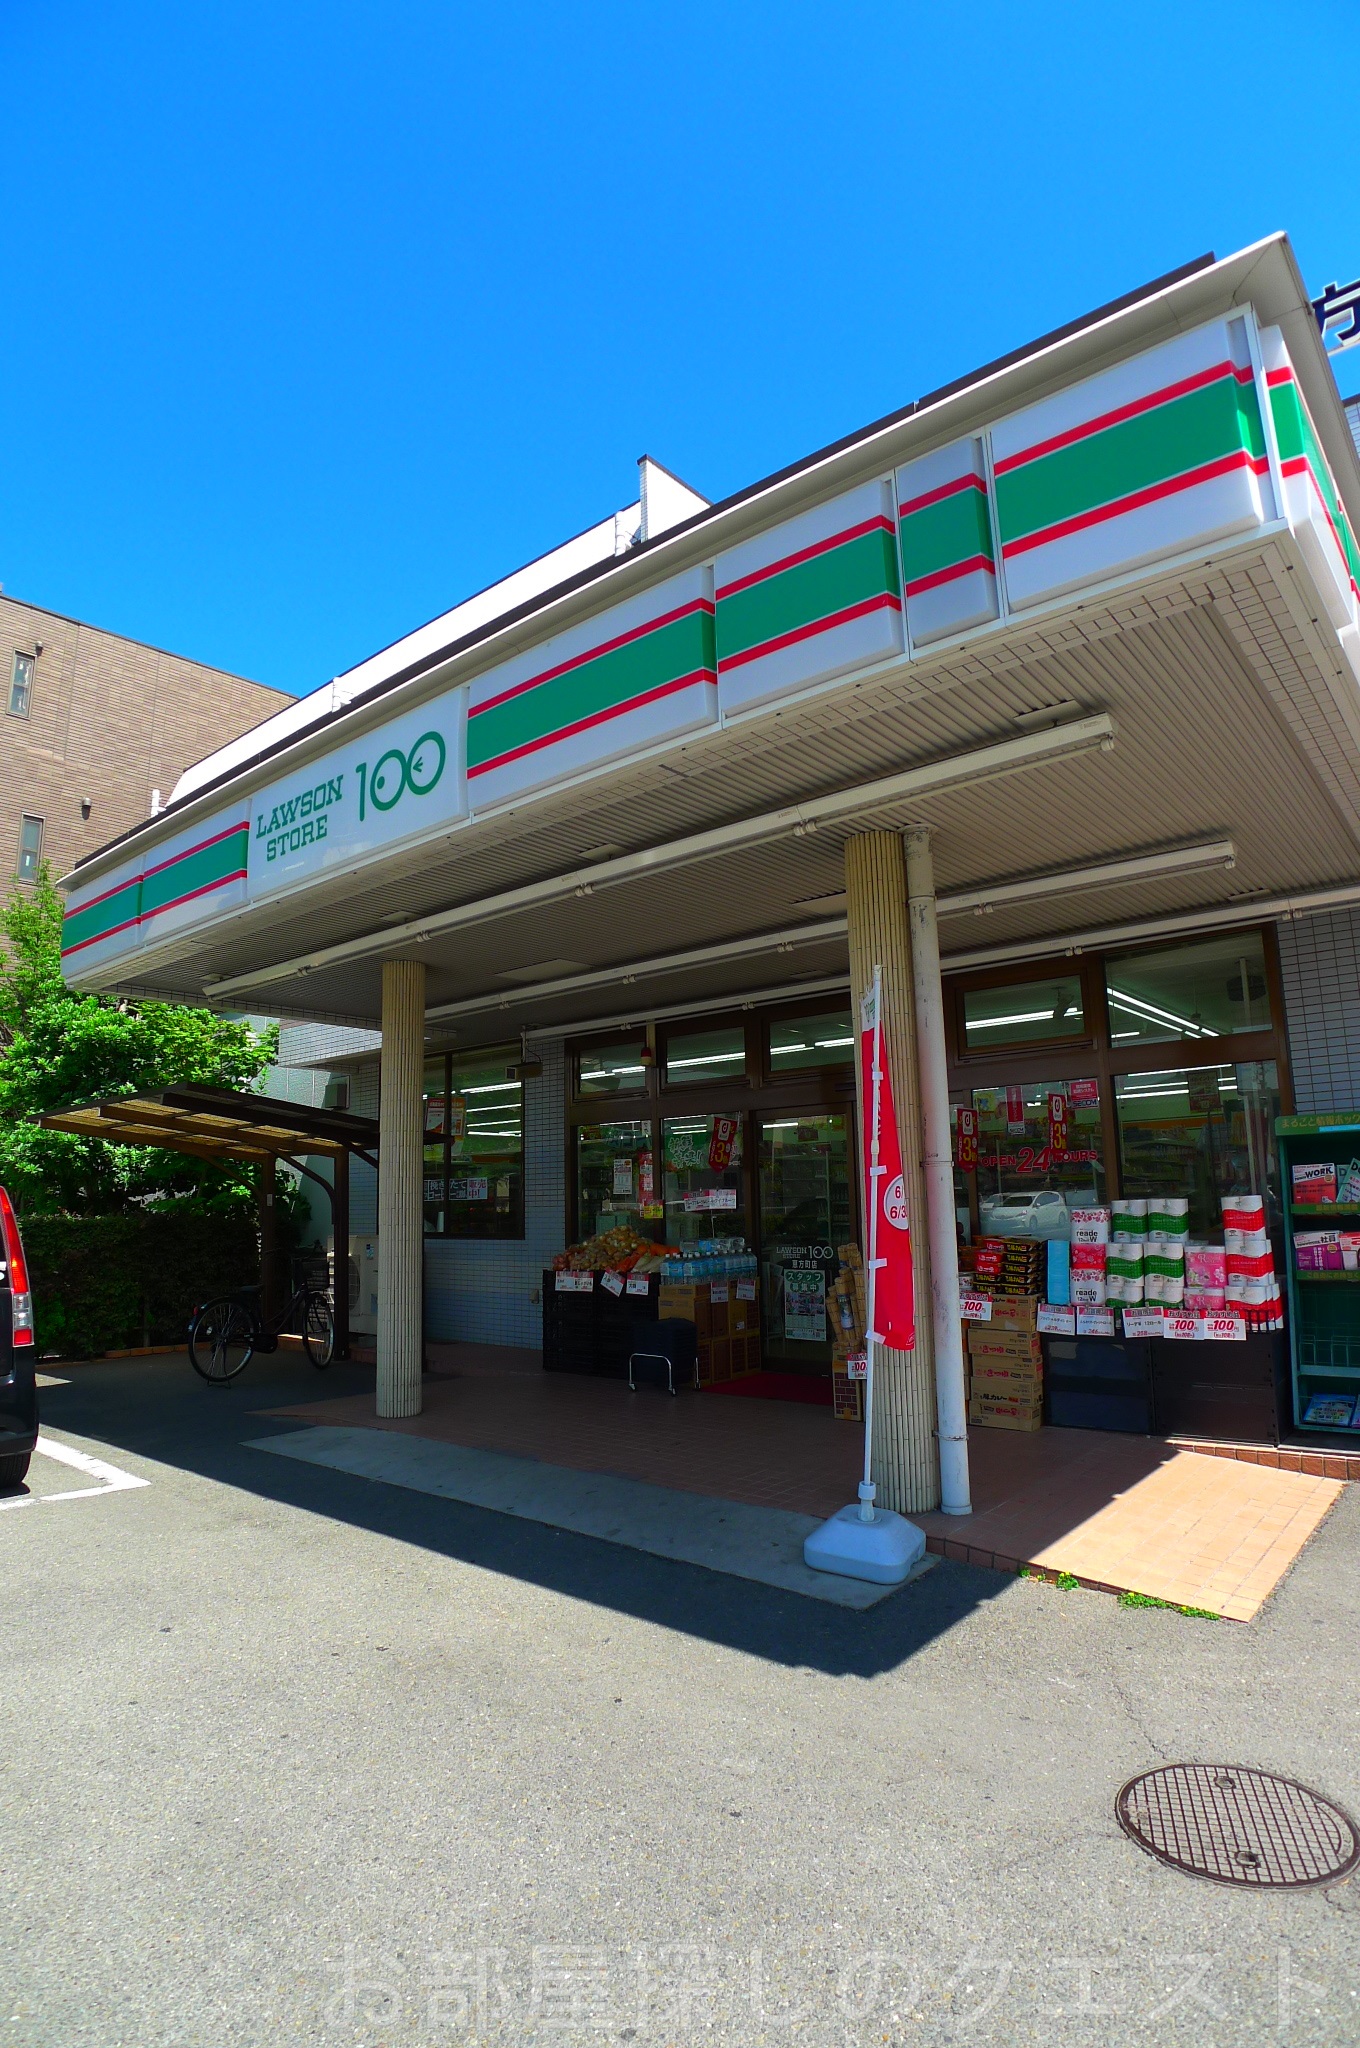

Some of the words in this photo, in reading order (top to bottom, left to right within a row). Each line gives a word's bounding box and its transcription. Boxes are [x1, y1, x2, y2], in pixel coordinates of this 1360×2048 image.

[256, 774, 343, 840] LAWSON
[355, 730, 446, 822] 100
[266, 814, 328, 862] STORE
[981, 1156, 1016, 1167] OPEN
[1016, 1147, 1050, 1173] 24
[1053, 1150, 1098, 1163] HOURS
[1305, 1167, 1333, 1178] WORK
[890, 1206, 908, 1219] 6/3
[1076, 1229, 1098, 1237] reade
[807, 1245, 834, 1259] 100
[787, 1272, 822, 1281] スタッフ
[792, 1282, 818, 1292] 募集中
[1075, 1289, 1097, 1297] reade
[964, 1301, 982, 1311] 100
[1174, 1320, 1195, 1330] 100
[1213, 1320, 1234, 1330] 100
